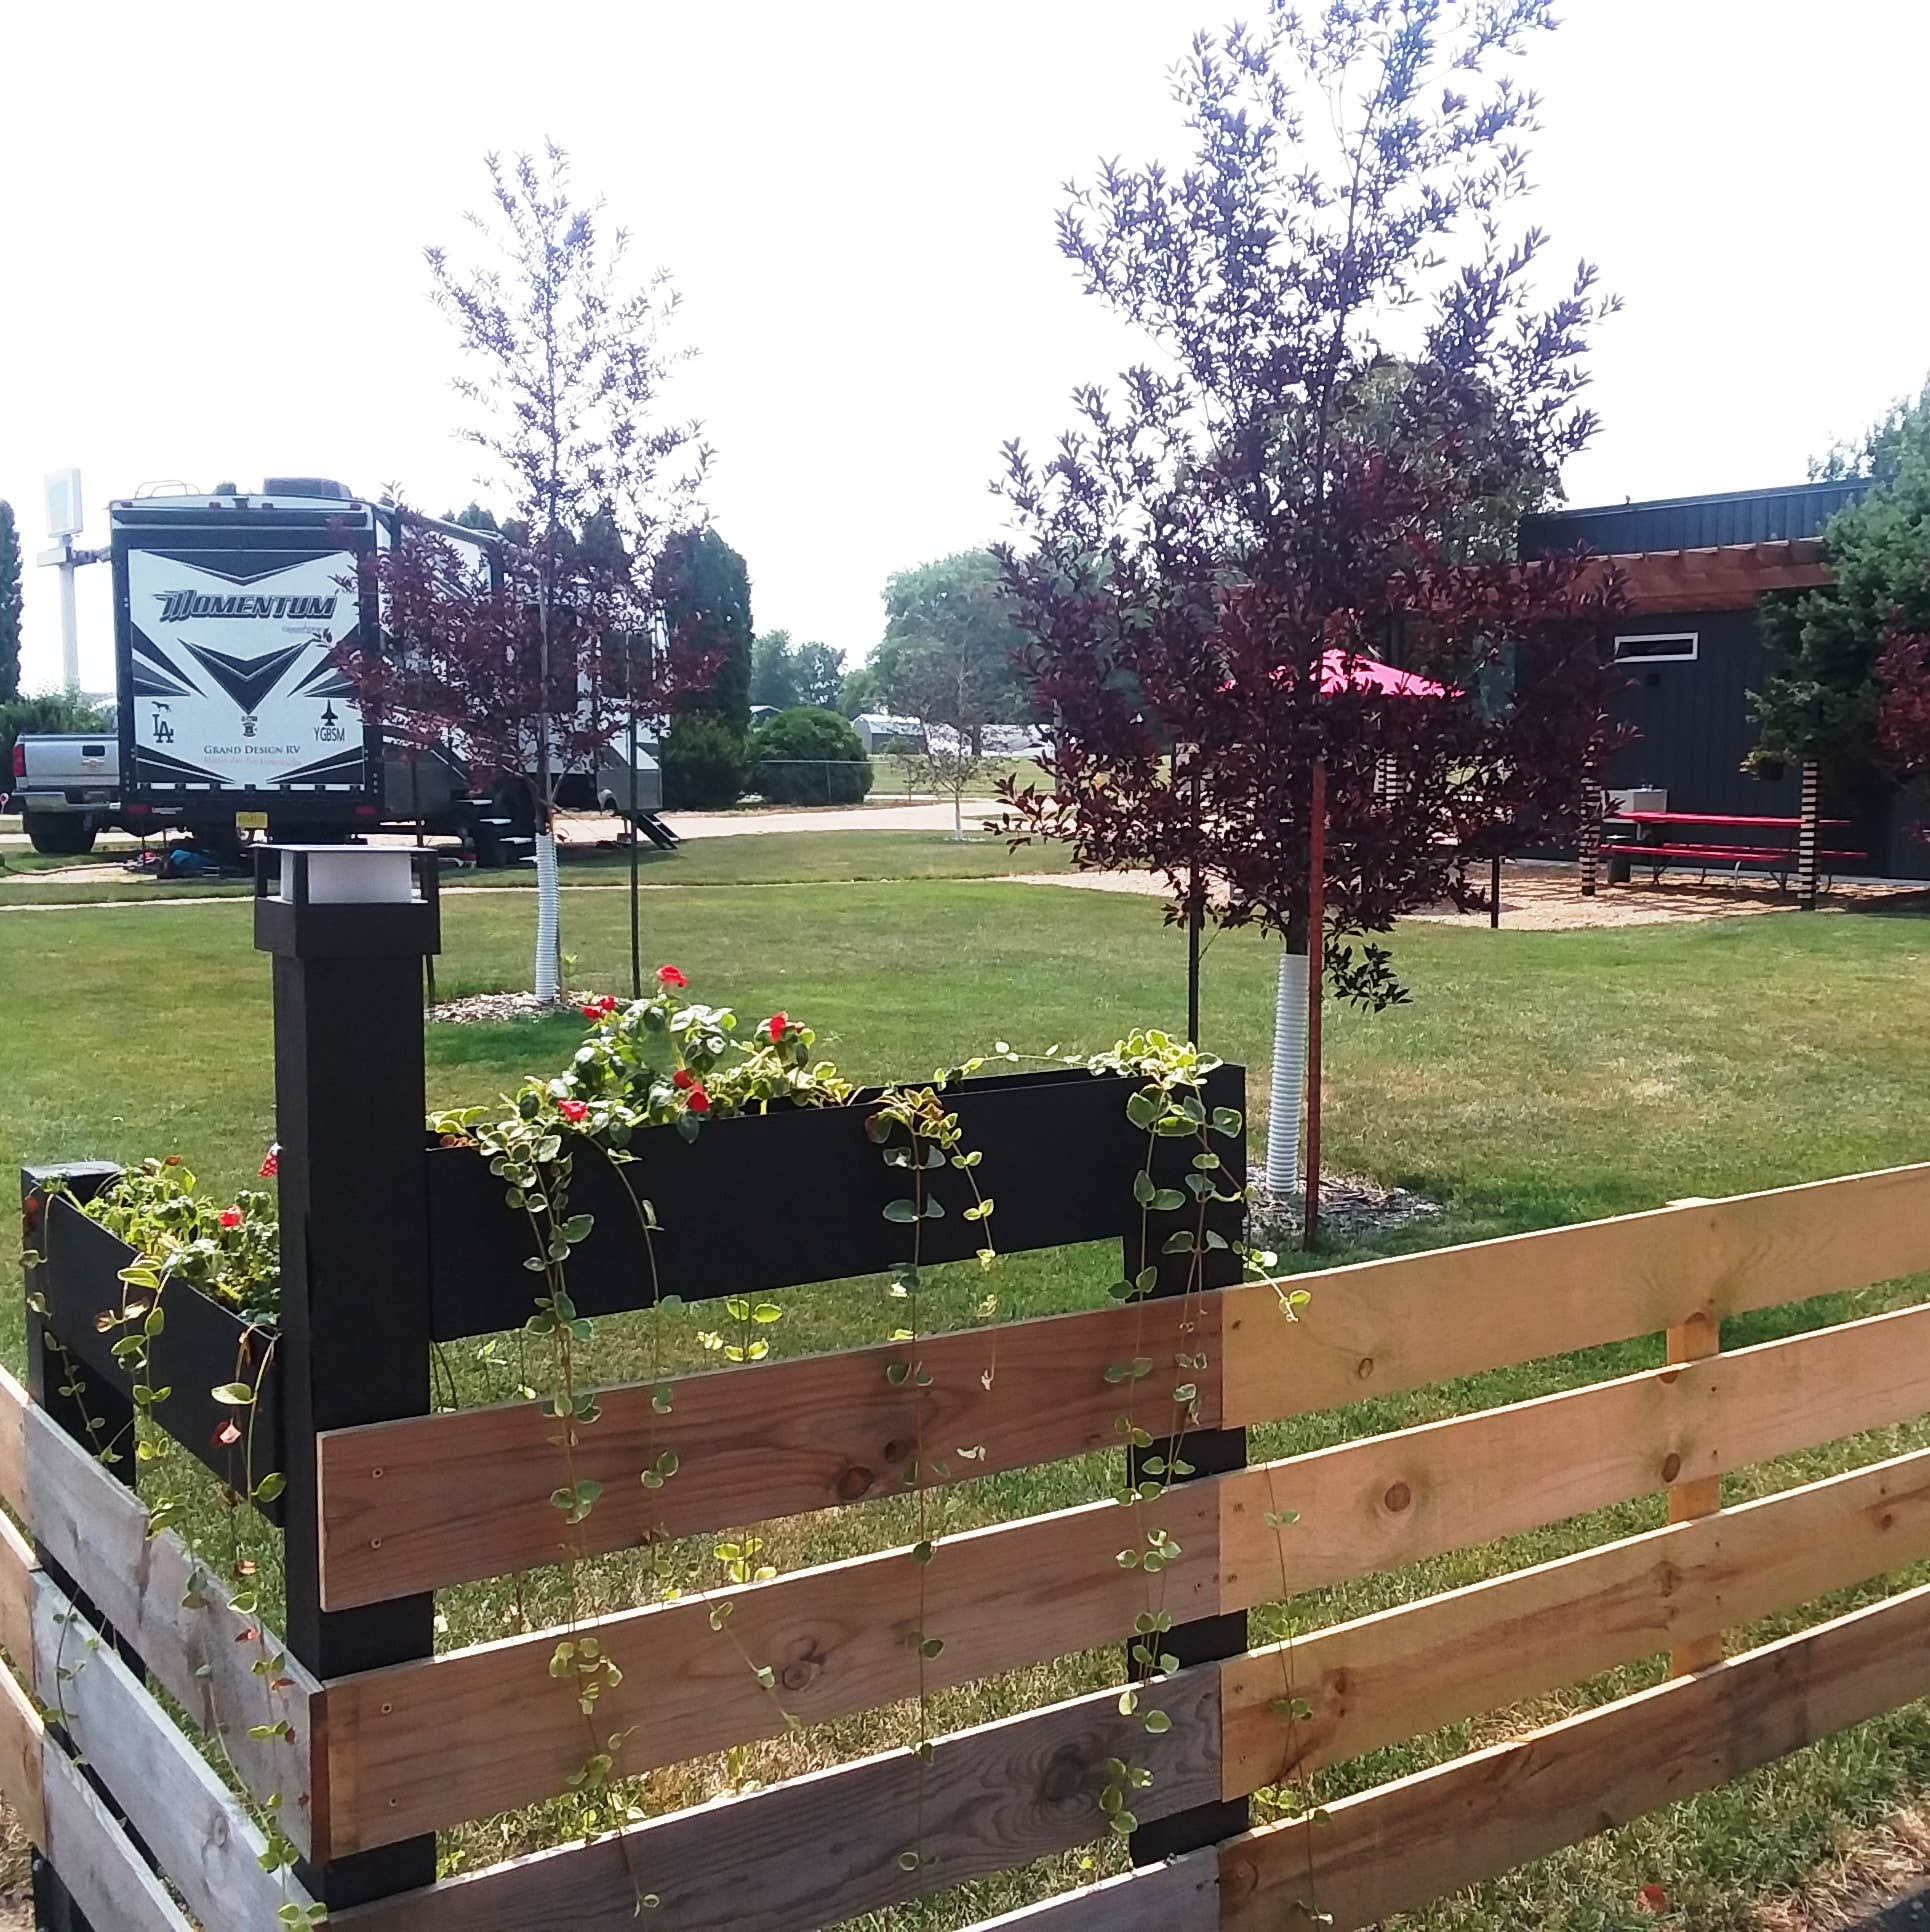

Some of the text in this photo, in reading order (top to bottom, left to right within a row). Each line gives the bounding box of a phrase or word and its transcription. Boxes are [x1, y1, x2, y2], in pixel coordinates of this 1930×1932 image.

[153, 589, 337, 623] MOMENTUM
[152, 713, 174, 743] LA
[313, 726, 345, 742] YGBSM
[203, 745, 301, 755] GRAND DESIGN RV
